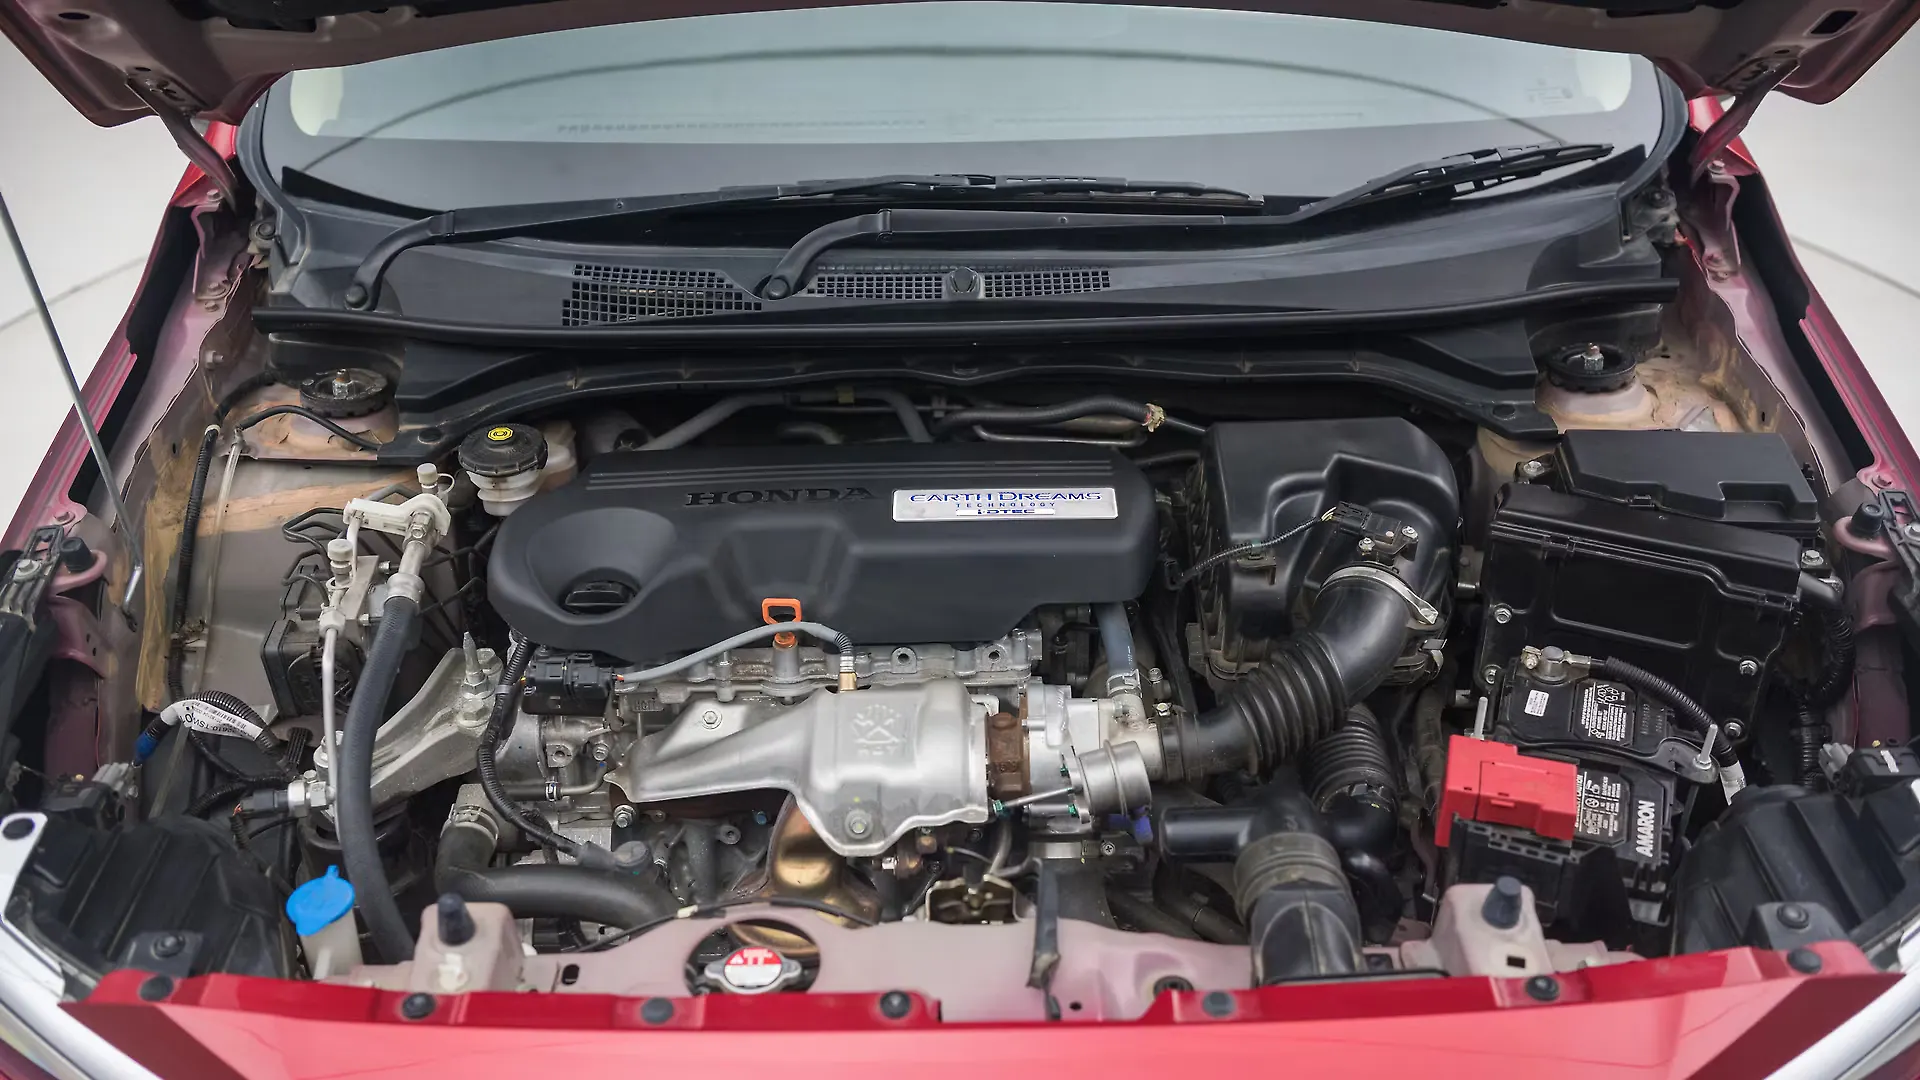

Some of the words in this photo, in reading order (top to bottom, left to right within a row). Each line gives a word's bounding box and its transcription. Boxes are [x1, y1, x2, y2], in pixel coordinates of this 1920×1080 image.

[684, 487, 876, 506] HONDA
[910, 493, 992, 502] EARTH
[999, 491, 1102, 501] DREAMS
[1636, 800, 1655, 858] AMARON
